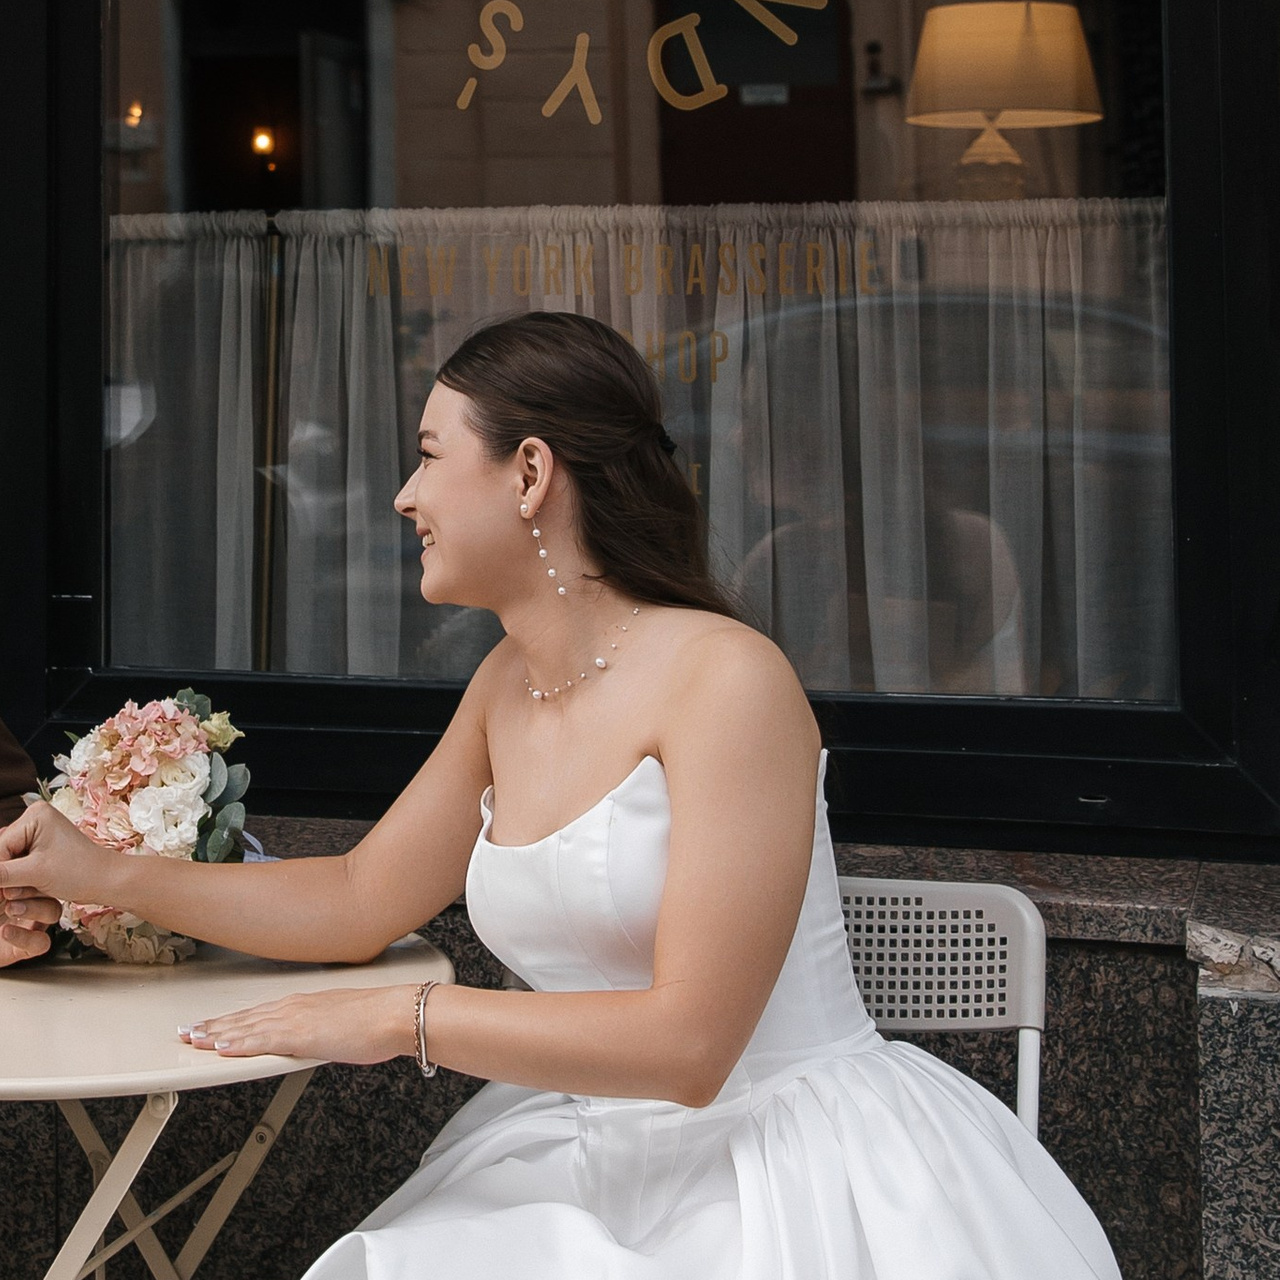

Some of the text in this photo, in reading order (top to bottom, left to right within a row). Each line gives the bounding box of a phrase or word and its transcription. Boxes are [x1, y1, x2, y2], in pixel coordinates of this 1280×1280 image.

[368, 242, 878, 297] NEW YORK BRASSERIE
